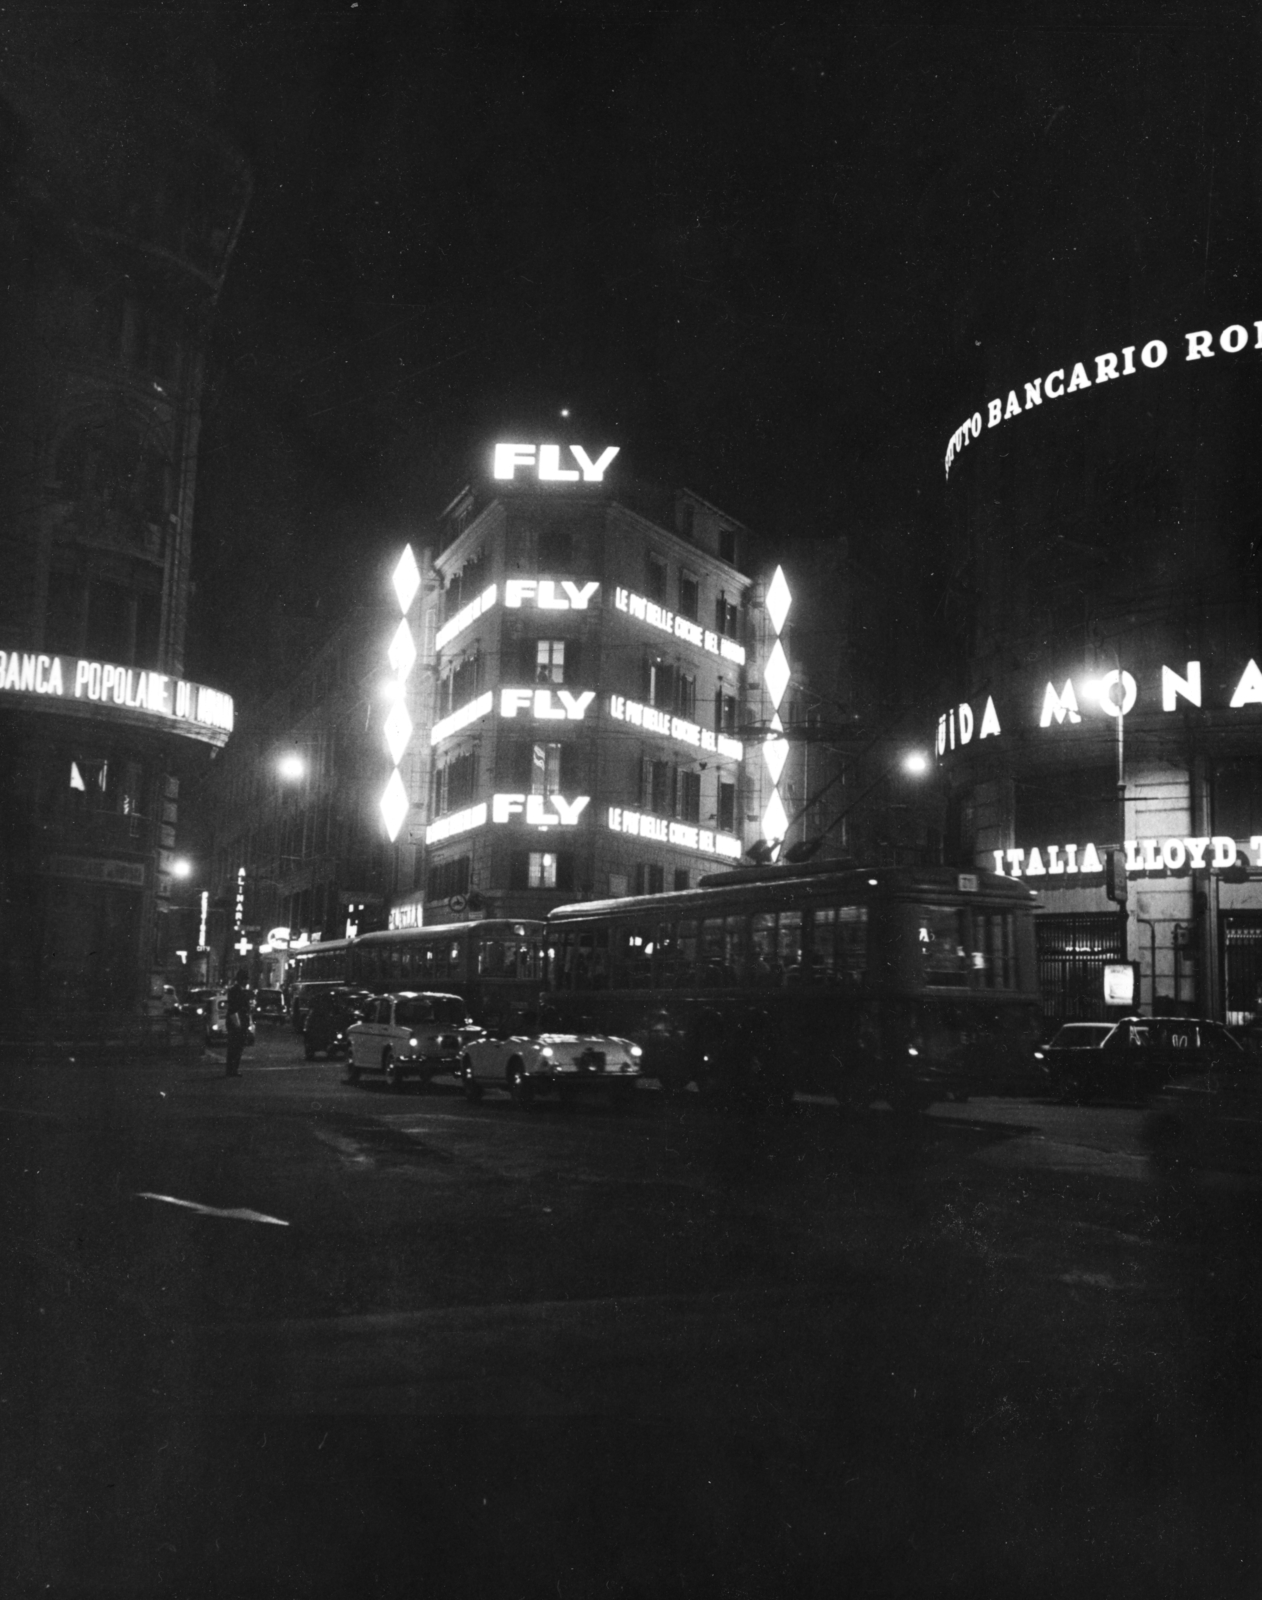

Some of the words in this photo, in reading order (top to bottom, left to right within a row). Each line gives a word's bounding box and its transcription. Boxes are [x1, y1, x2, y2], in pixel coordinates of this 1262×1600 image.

[988, 340, 1167, 428] BANCARIO
[494, 444, 619, 481] FLY
[506, 580, 598, 609] FLY
[615, 587, 627, 611] LE
[0, 651, 63, 695] BANCA
[75, 660, 169, 713] POPOLARE
[176, 680, 191, 717] DI
[501, 689, 594, 719] FLY
[610, 694, 624, 719] LE
[935, 695, 1001, 759] UIDA
[493, 794, 589, 826] FLY
[608, 807, 621, 831] LE
[993, 843, 1103, 876] ITALIA
[1124, 837, 1237, 870] LLOYD
